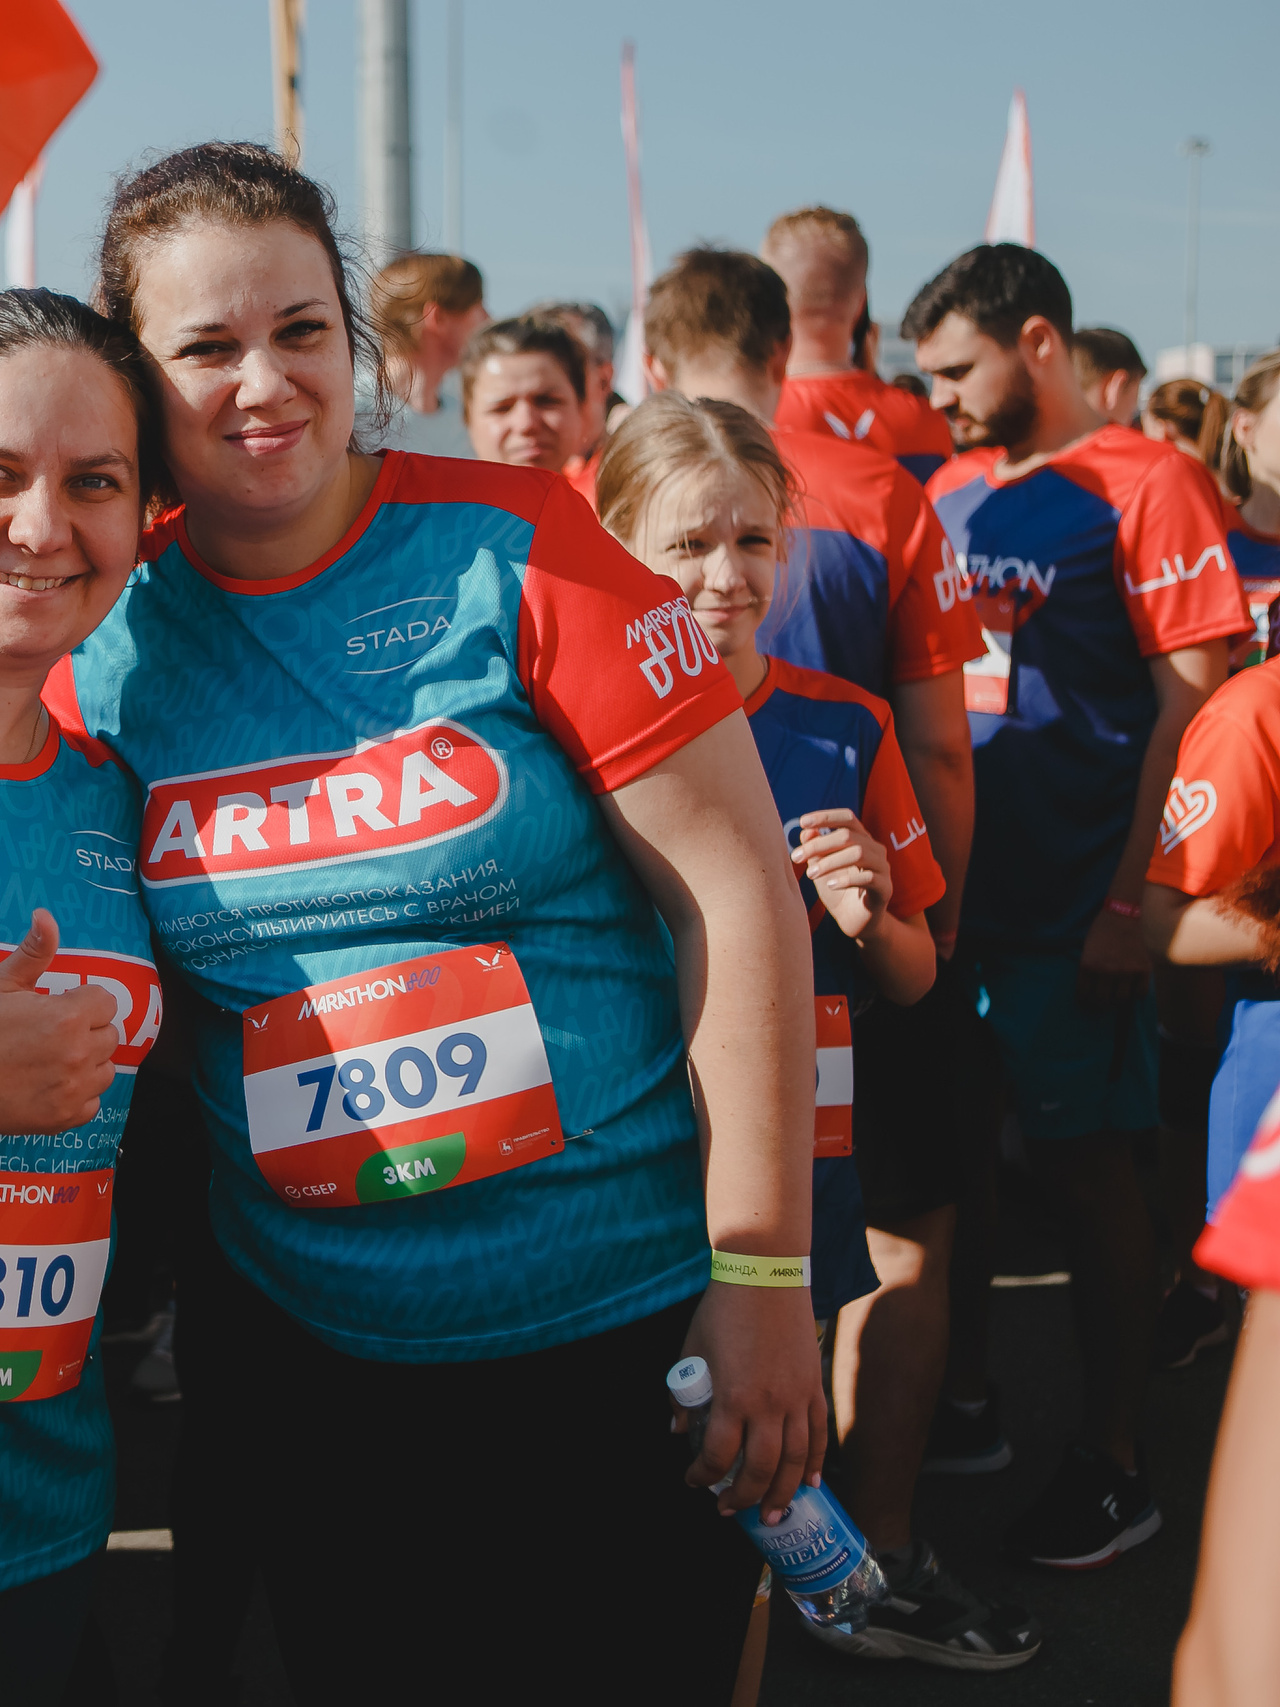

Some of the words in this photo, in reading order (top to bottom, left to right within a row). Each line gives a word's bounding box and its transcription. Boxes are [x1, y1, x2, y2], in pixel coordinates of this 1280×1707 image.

[346, 615, 452, 656] STADA
[148, 750, 478, 864] ARTRA
[426, 877, 517, 914] ВРАЧОМ
[155, 908, 245, 935] ИМЕЮТСЯ
[296, 1032, 488, 1133] 7809
[301, 1182, 338, 1197] СБЕР
[769, 1267, 804, 1278] MARATH
